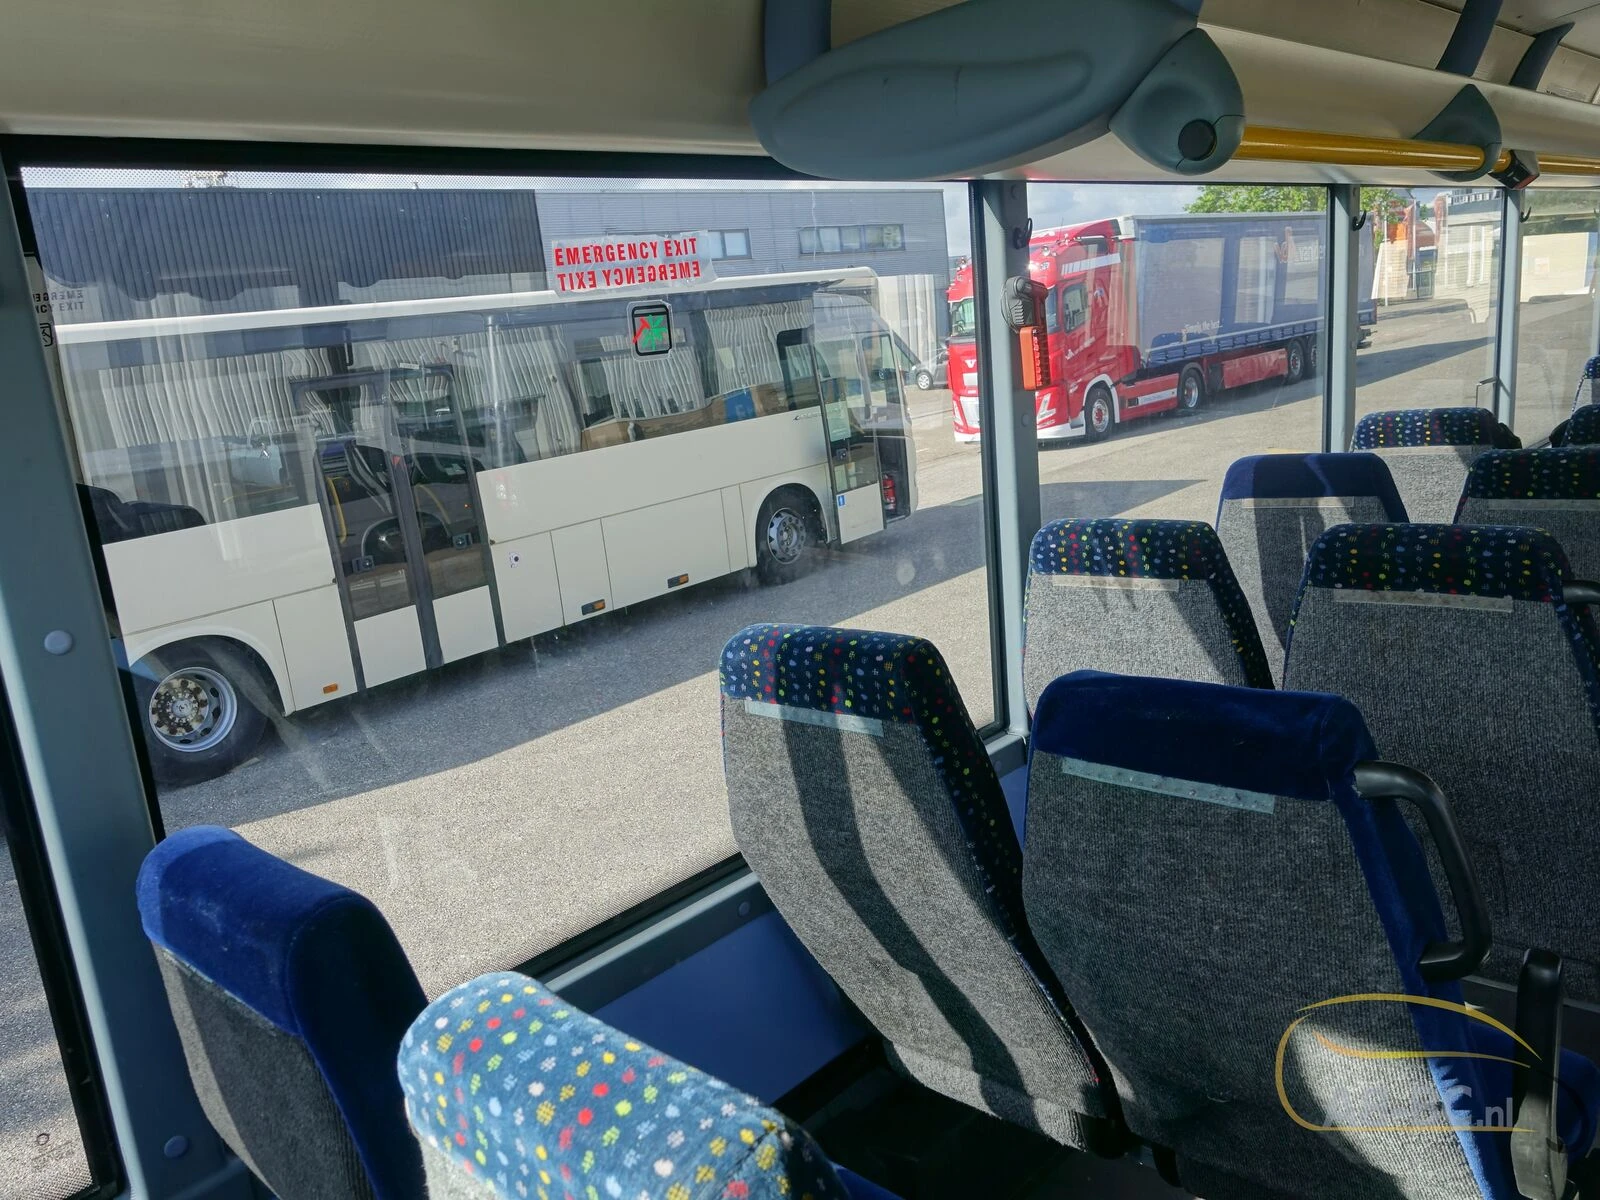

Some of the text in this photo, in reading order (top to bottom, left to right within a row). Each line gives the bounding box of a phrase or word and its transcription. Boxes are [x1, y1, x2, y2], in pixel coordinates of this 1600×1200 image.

[554, 237, 698, 267] EMERGENCY EXIT
[59, 302, 84, 312] EXIT
